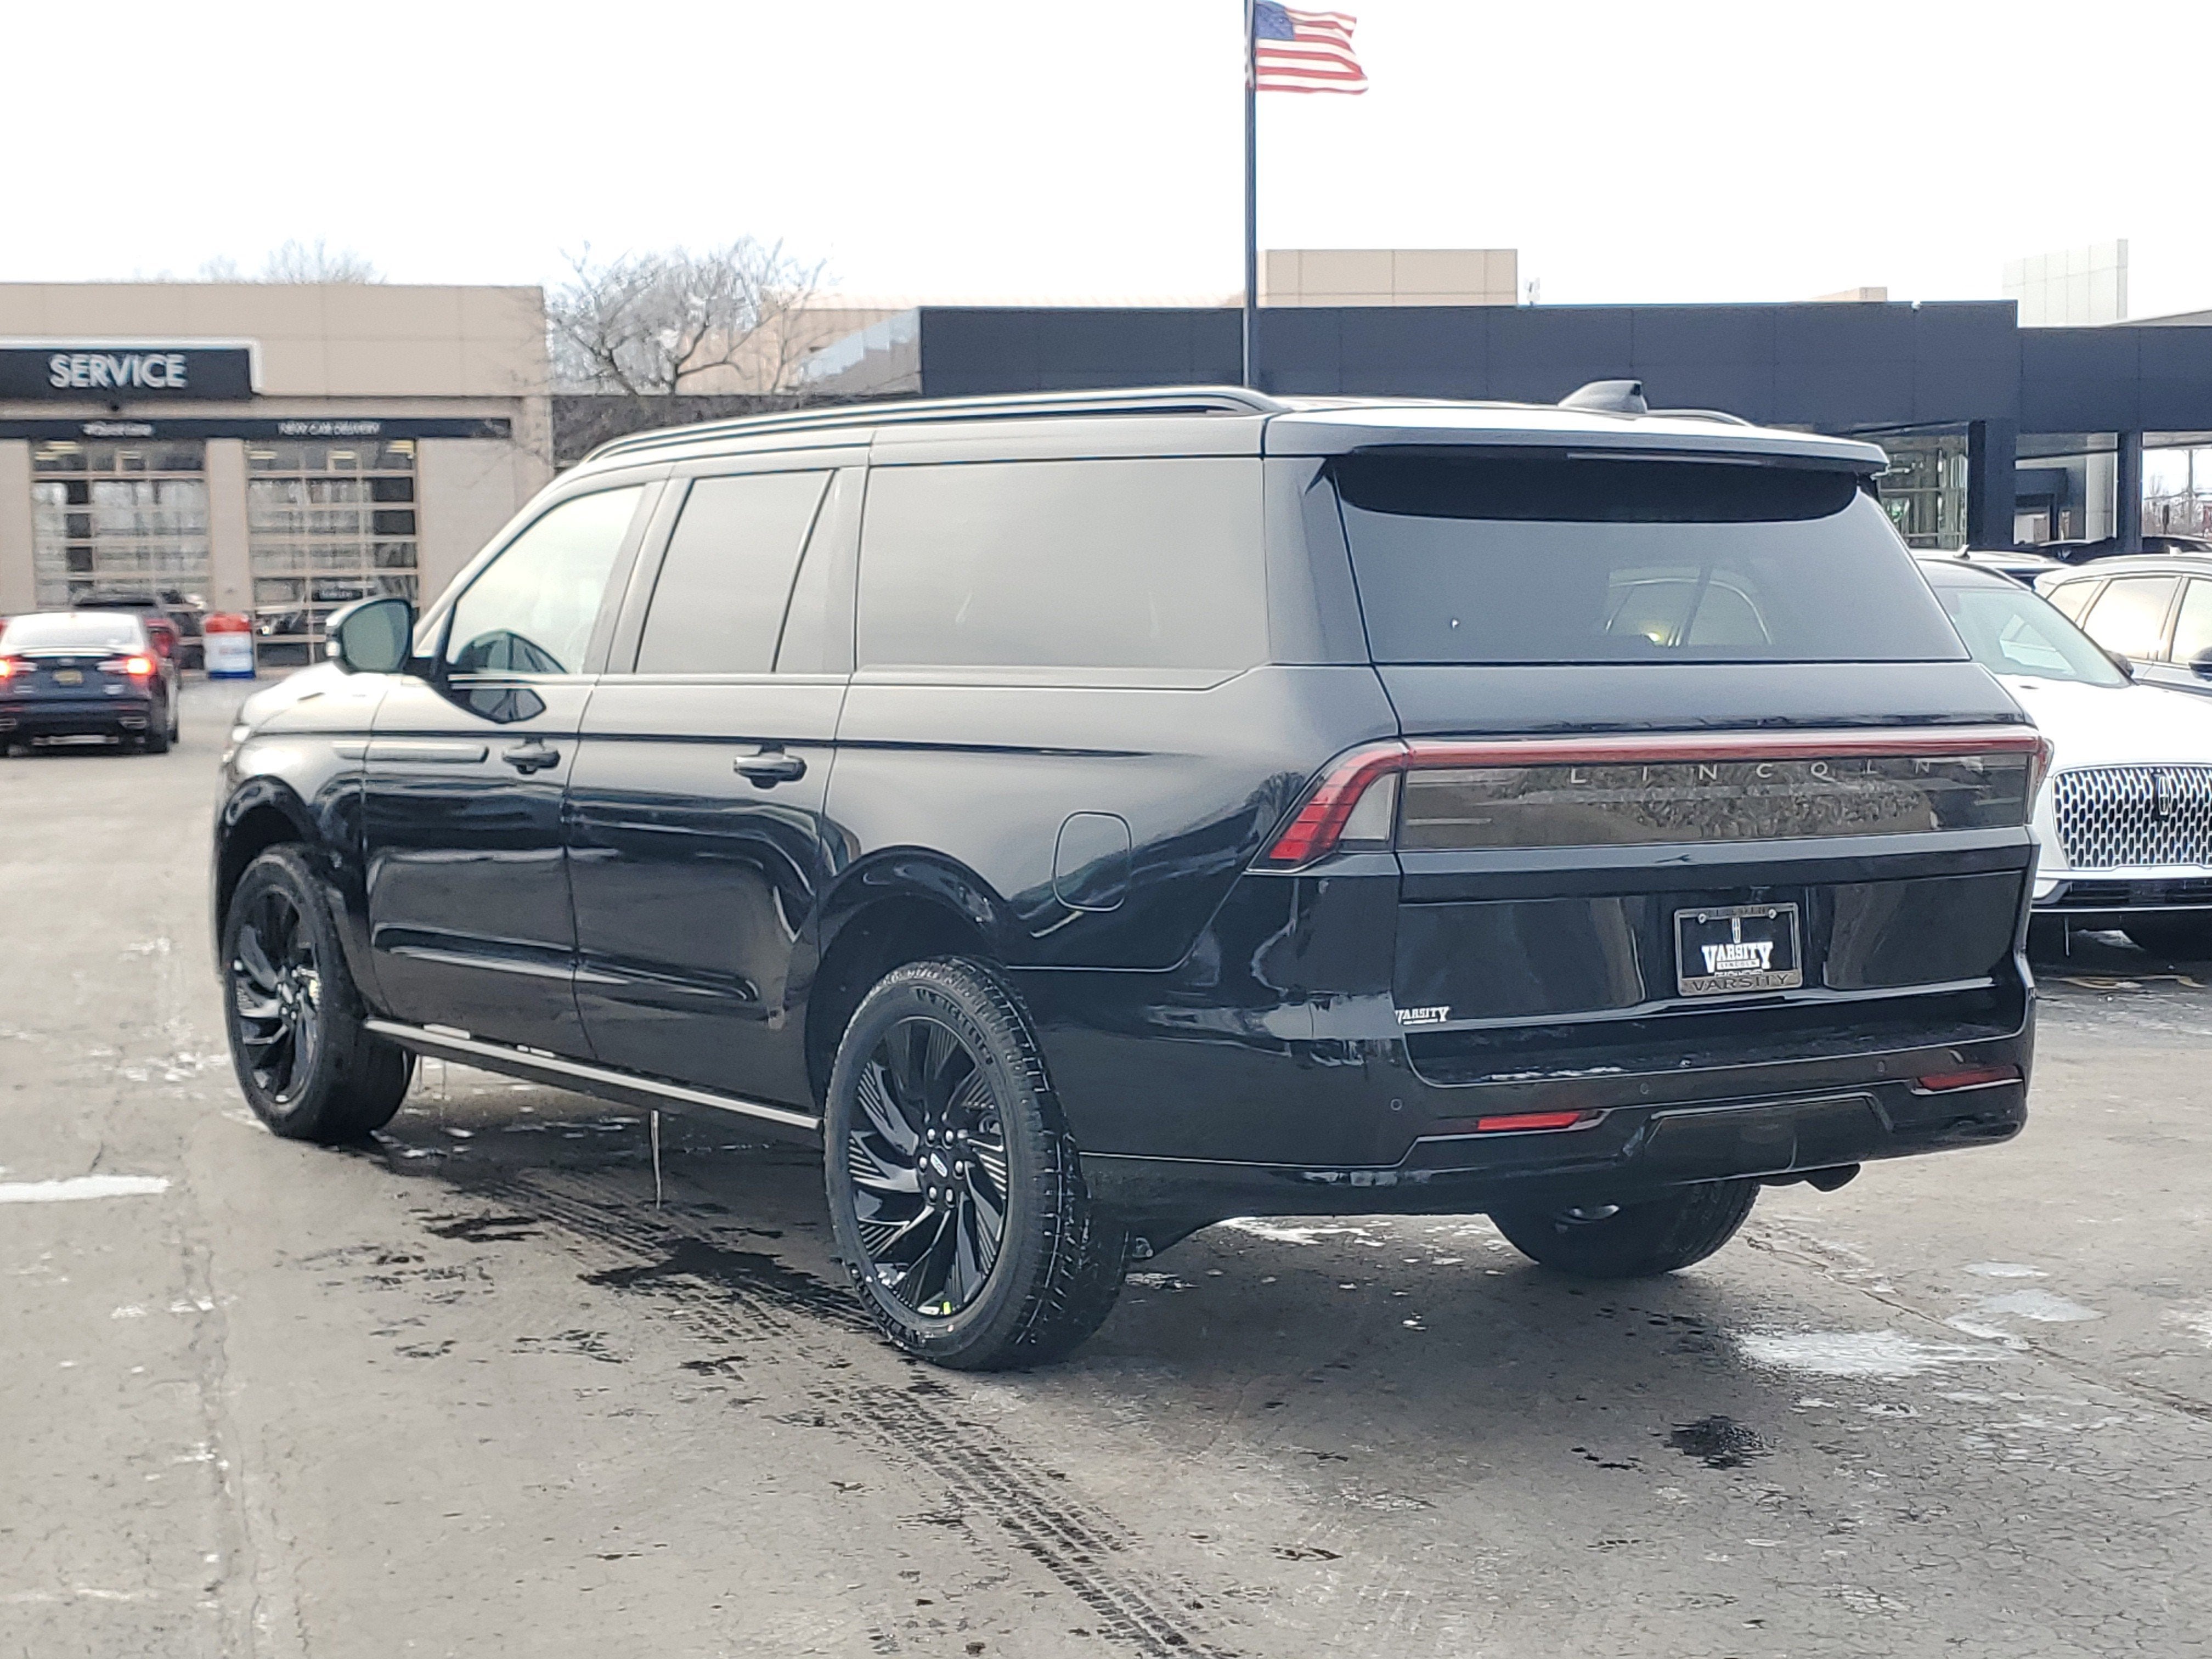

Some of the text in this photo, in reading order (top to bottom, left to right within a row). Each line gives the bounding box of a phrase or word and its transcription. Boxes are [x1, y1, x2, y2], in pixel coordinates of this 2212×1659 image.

[50, 353, 187, 387] SERVICE
[1570, 758, 1931, 784] LINCOLN
[1701, 941, 1773, 973] VARSITY
[1692, 974, 1789, 991] VARSITY
[1394, 1006, 1450, 1025] VARSITY
